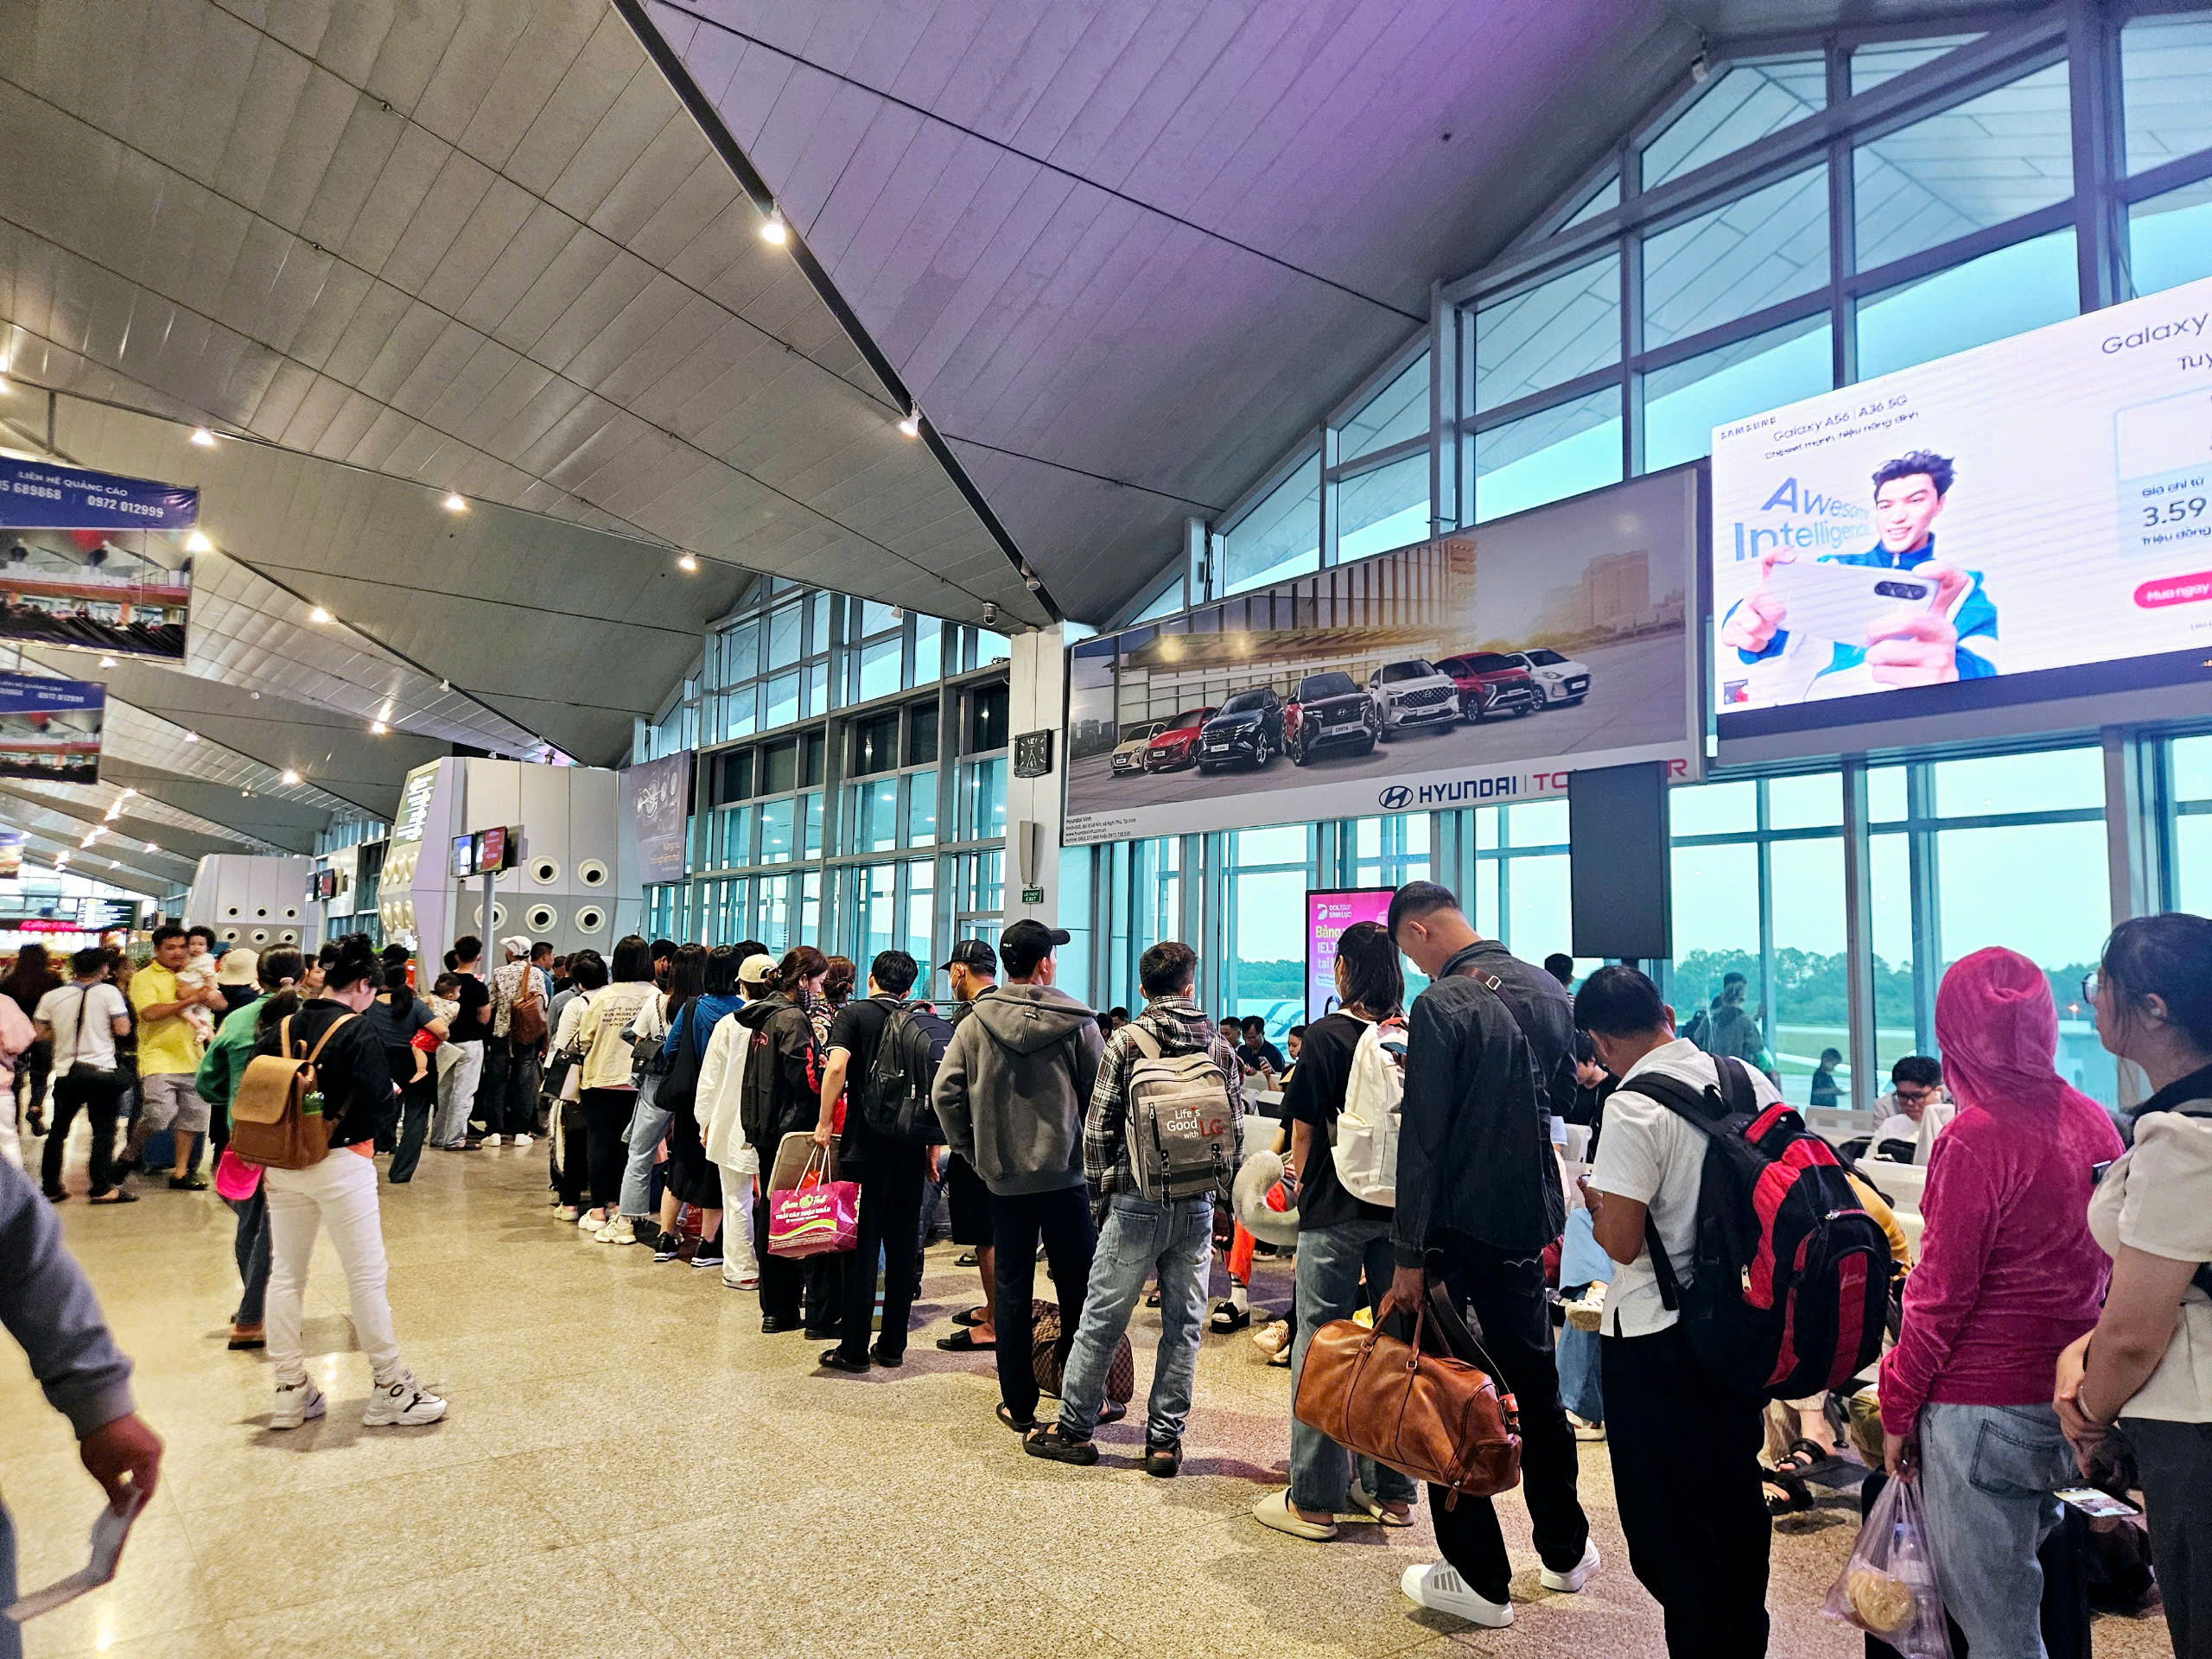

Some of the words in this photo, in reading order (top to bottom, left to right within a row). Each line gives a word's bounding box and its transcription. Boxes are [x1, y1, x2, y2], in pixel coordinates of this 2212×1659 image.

[2101, 312, 2209, 354] Galaxy
[1773, 420, 1823, 442] Galaxy
[1825, 411, 1850, 428] A56
[1859, 402, 1885, 417] A36
[63, 478, 104, 493] QUẢNG
[105, 486, 129, 497] CÁO
[87, 494, 118, 511] 0972
[120, 501, 165, 518] 012999
[2143, 497, 2208, 528] 3.59
[1419, 776, 1517, 804] HYUNDAI
[1066, 817, 1083, 825] Hyundai
[1166, 1116, 1198, 1132] Good
[1183, 1130, 1198, 1140] with
[1199, 1118, 1224, 1137] LG
